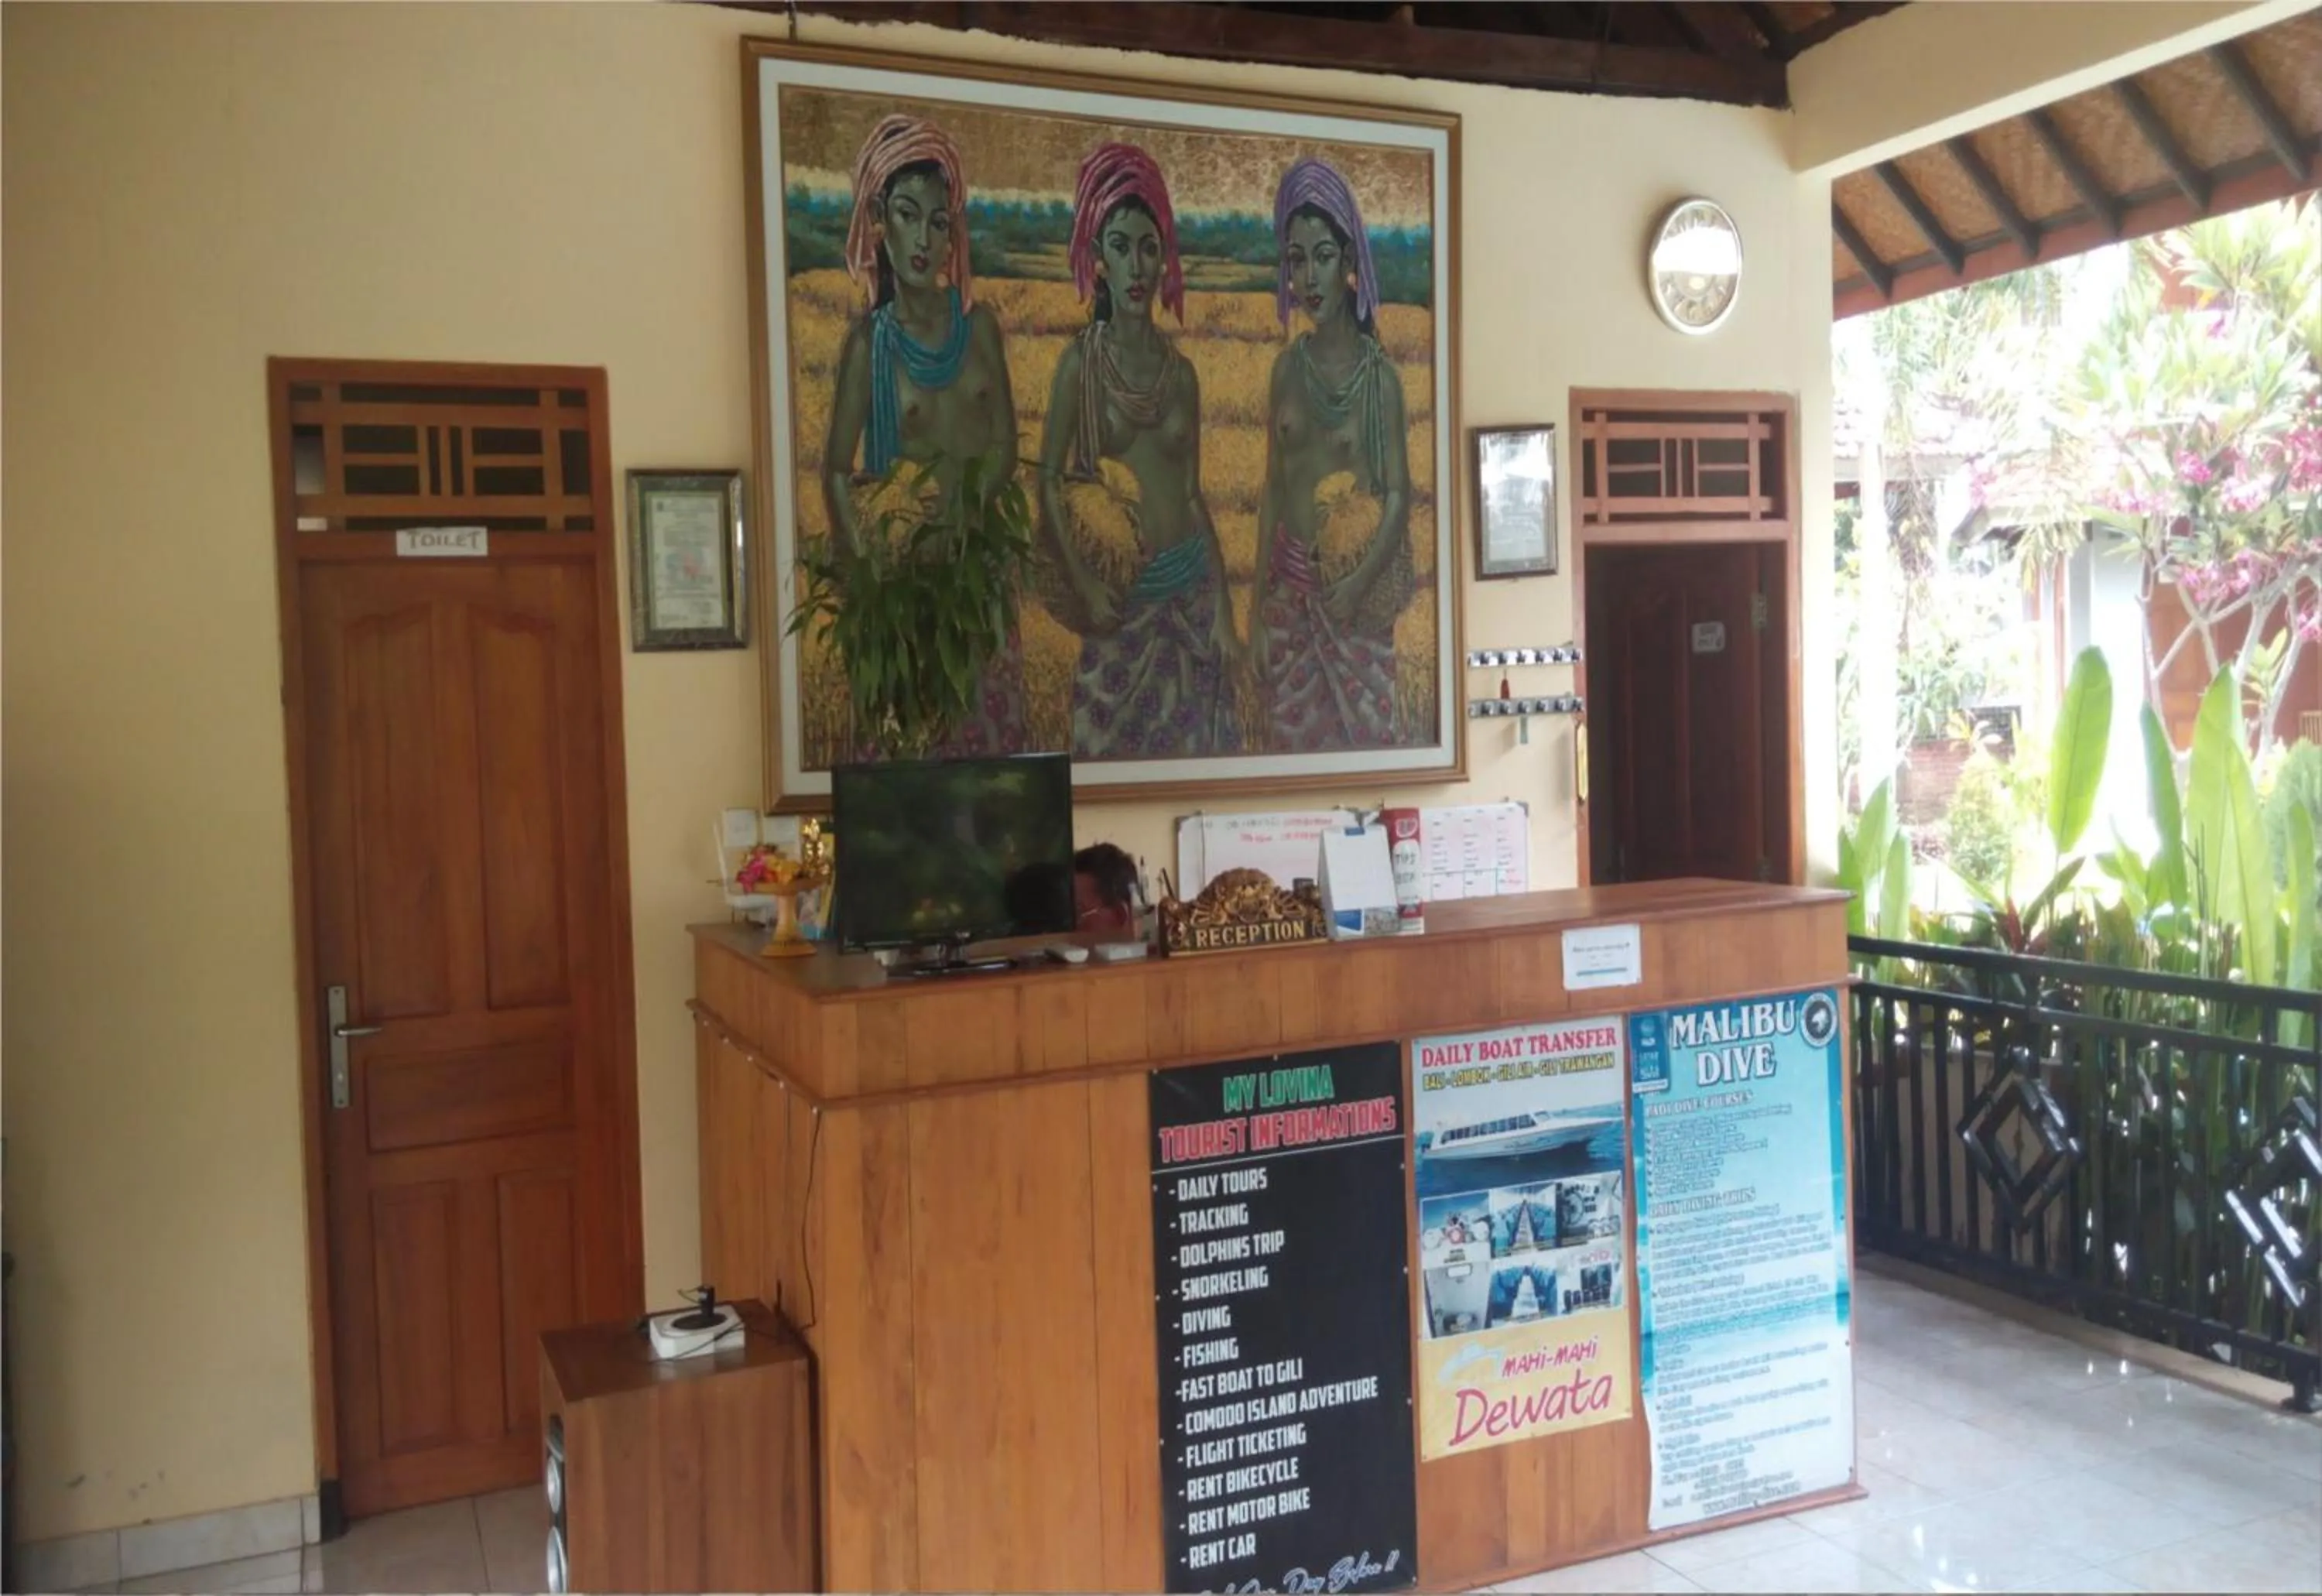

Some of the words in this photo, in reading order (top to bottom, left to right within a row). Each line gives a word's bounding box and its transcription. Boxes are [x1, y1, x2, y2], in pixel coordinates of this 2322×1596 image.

[406, 529, 481, 549] TOILET
[1196, 919, 1306, 948] RECEPTION
[1670, 999, 1797, 1050] MALIBU
[1421, 1042, 1474, 1068] DAILY
[1479, 1037, 1524, 1061] BOAT
[1528, 1026, 1617, 1056] TRANSFER
[1696, 1041, 1778, 1087] DIVE
[1222, 1074, 1257, 1113] MY
[1259, 1064, 1336, 1108] LOVINA
[1453, 1066, 1491, 1087] LOMBOK
[1159, 1118, 1247, 1163] TOURIST
[1250, 1096, 1397, 1152] INFORMATIONS
[1177, 1173, 1221, 1201] DAILY
[1221, 1167, 1268, 1194] TOURS
[1179, 1203, 1249, 1235] TRACKING
[1180, 1236, 1251, 1268] DOLPHINS
[1252, 1230, 1285, 1255] TRIP
[1181, 1265, 1269, 1301] SNORKELING
[1182, 1305, 1231, 1335] DIVING
[1183, 1337, 1239, 1368] FISHING
[1181, 1376, 1214, 1402] FAST
[1217, 1368, 1252, 1394] BOAT
[1255, 1363, 1275, 1386] TO
[1276, 1358, 1303, 1384] GILI
[1185, 1402, 1245, 1435] COMODO
[1247, 1392, 1297, 1423] ISLAND
[1299, 1375, 1378, 1412] ADVENTURE
[1448, 1368, 1613, 1447] Dewata
[1186, 1437, 1235, 1468] FLIGHT
[1237, 1423, 1307, 1457] TICKETING
[1187, 1473, 1224, 1502] RENT
[1226, 1457, 1299, 1495] BIKECYCLE
[1188, 1507, 1224, 1536] RENT
[1227, 1495, 1276, 1527] MOTOR
[1278, 1487, 1311, 1515] BIKE
[1189, 1540, 1226, 1570] RENT
[1228, 1533, 1257, 1560] CAR
